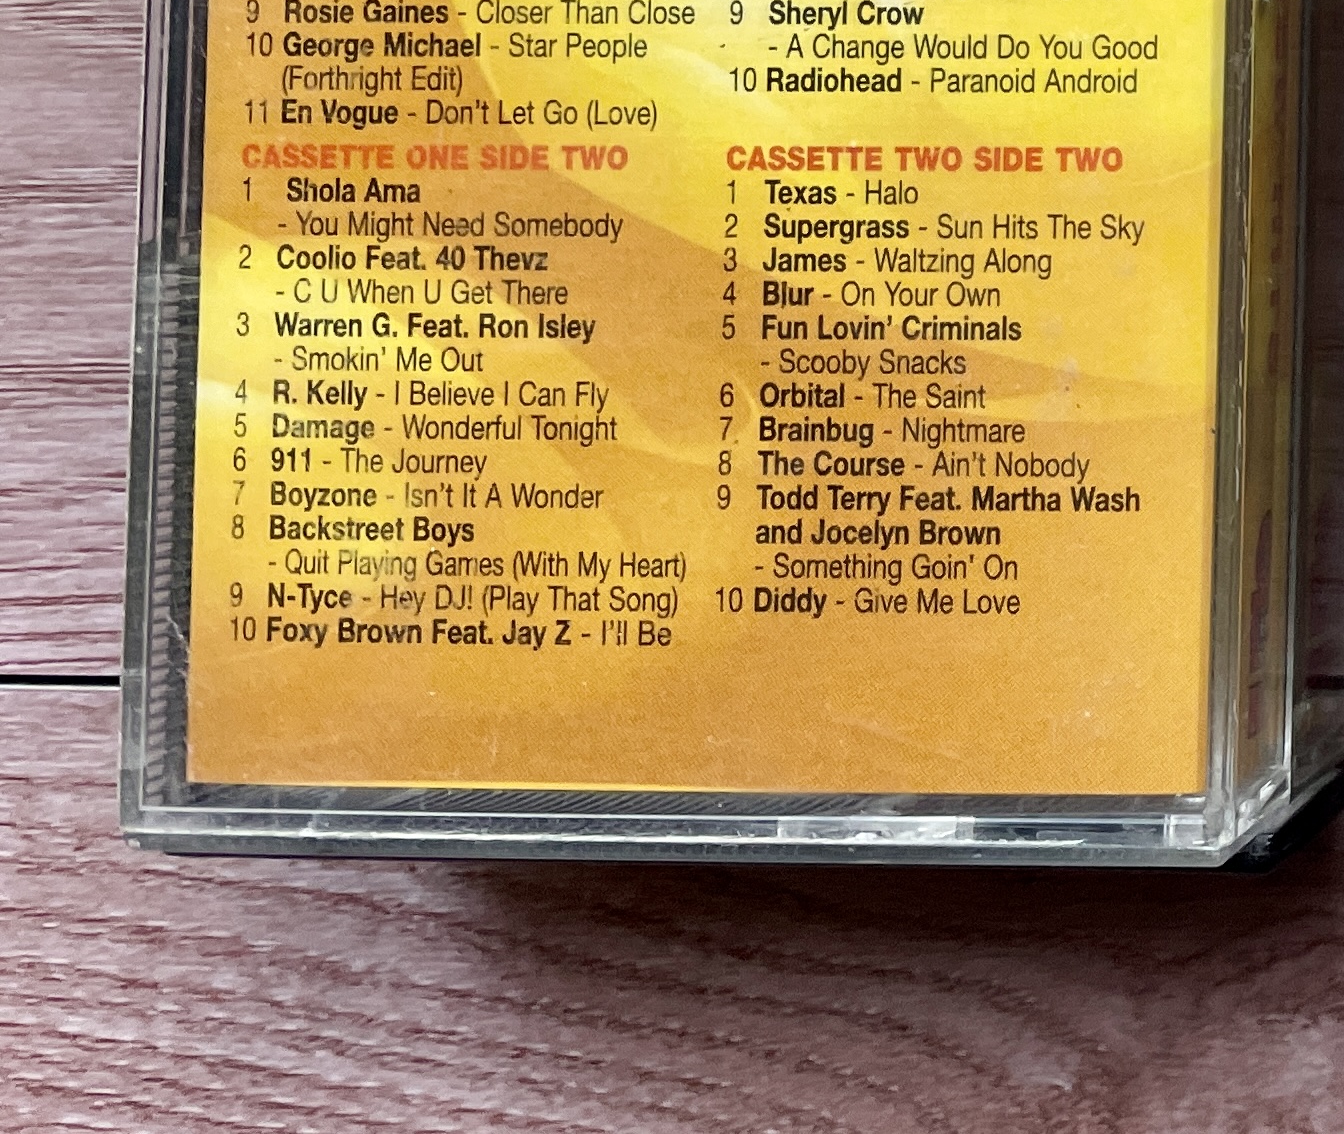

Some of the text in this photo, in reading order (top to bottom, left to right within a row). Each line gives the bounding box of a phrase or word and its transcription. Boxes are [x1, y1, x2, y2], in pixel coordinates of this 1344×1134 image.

[242, 143, 628, 171] CASSETTE ONE SIDE TWO
[727, 146, 1122, 172] CASSETTE TWO SIDE TWO
[722, 314, 1021, 341] 5 Fun Lovin' Criminals
[232, 514, 474, 547] 8 Backstreet Boys
